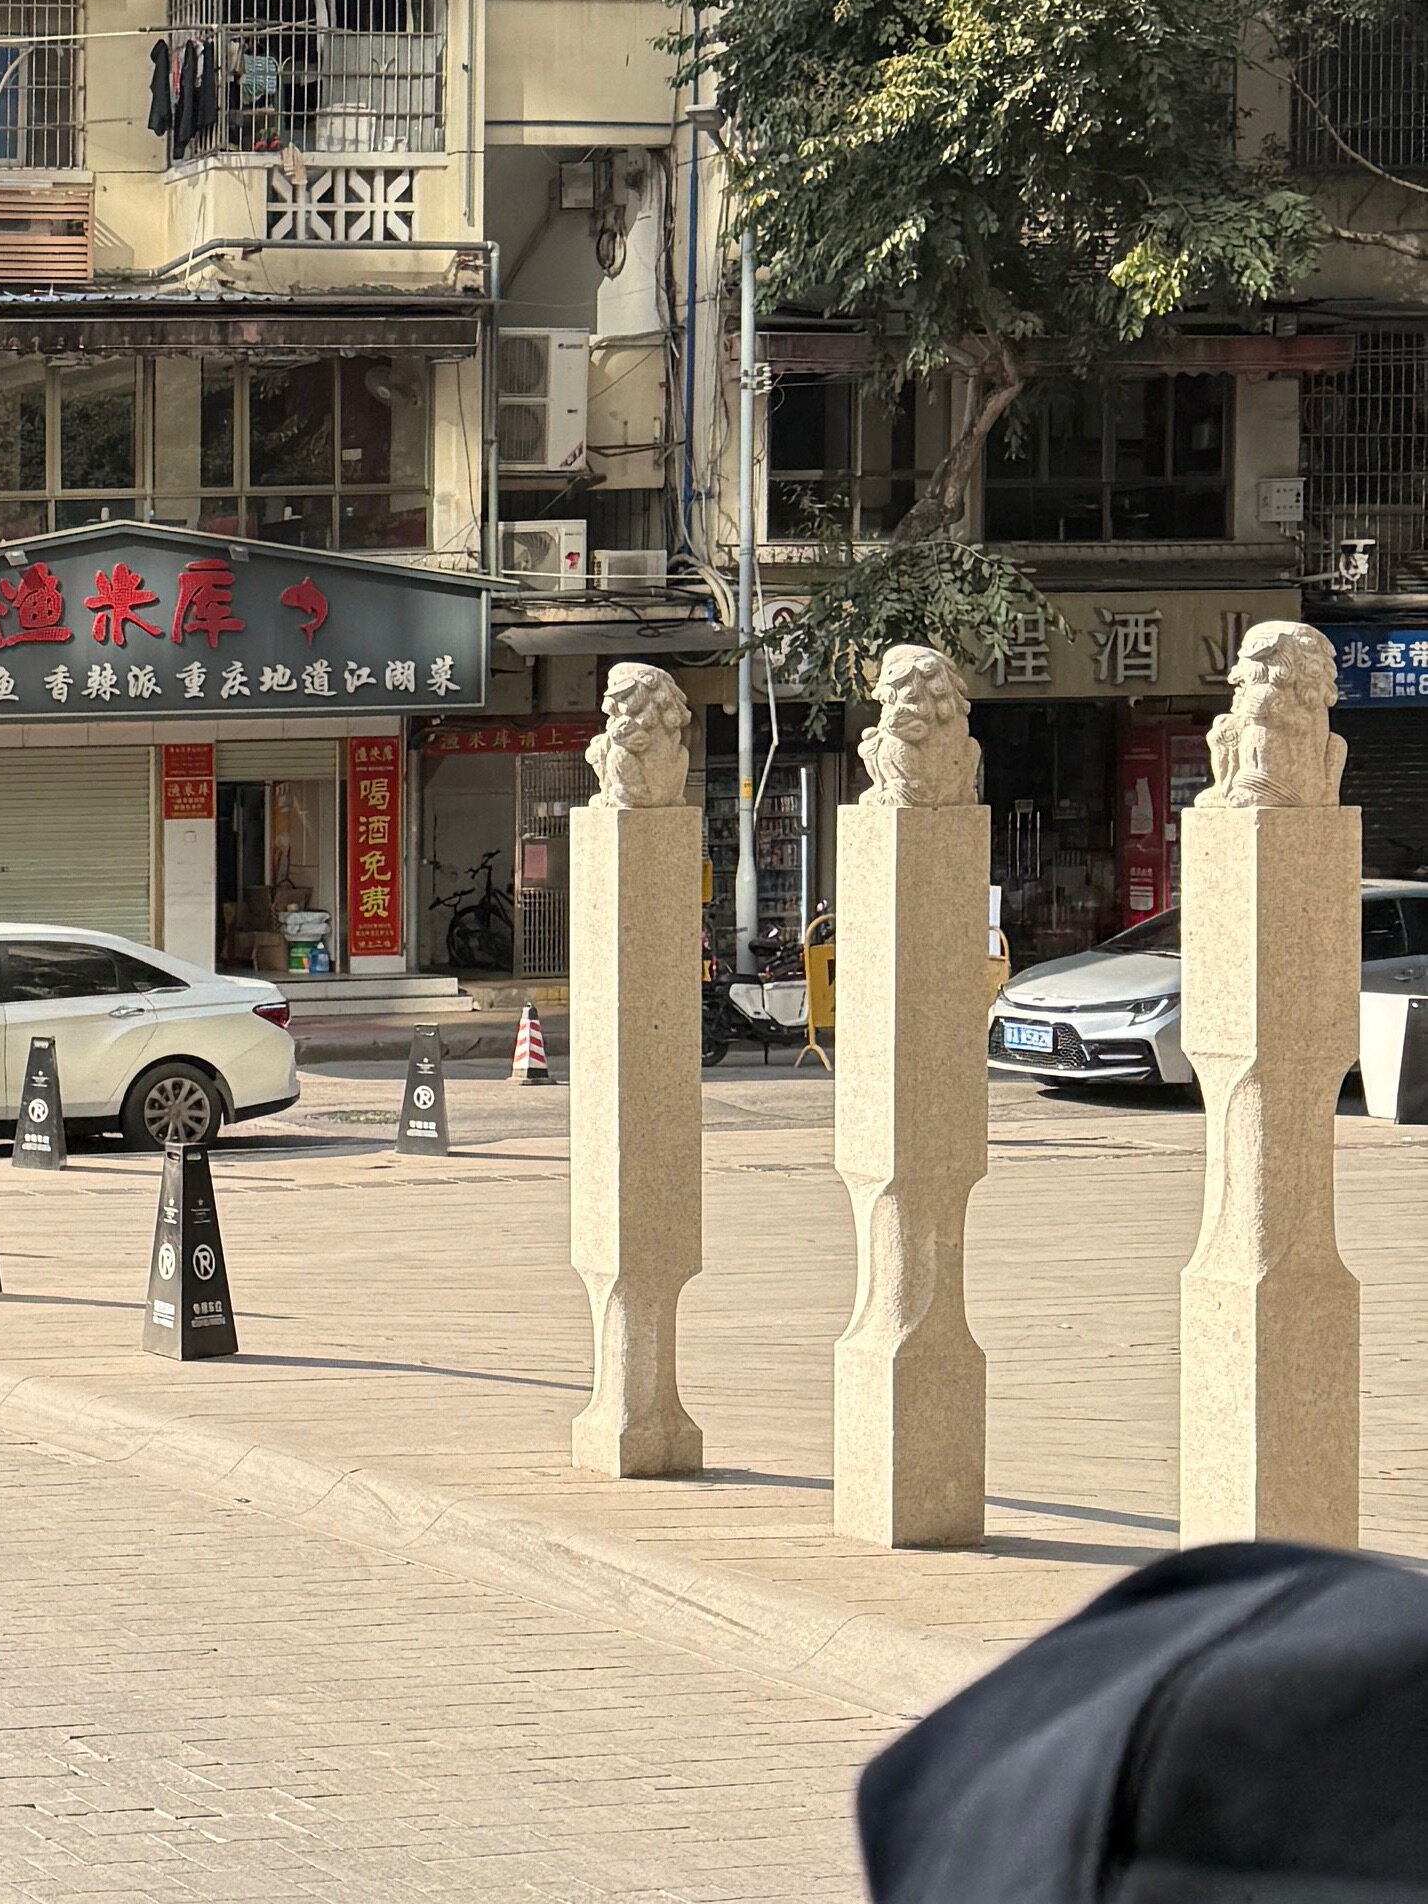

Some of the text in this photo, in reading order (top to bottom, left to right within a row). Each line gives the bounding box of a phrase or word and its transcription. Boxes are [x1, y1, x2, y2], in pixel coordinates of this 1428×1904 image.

[175, 655, 461, 699] 重庆地道江湖菜
[358, 778, 391, 918] 喝酒免费
